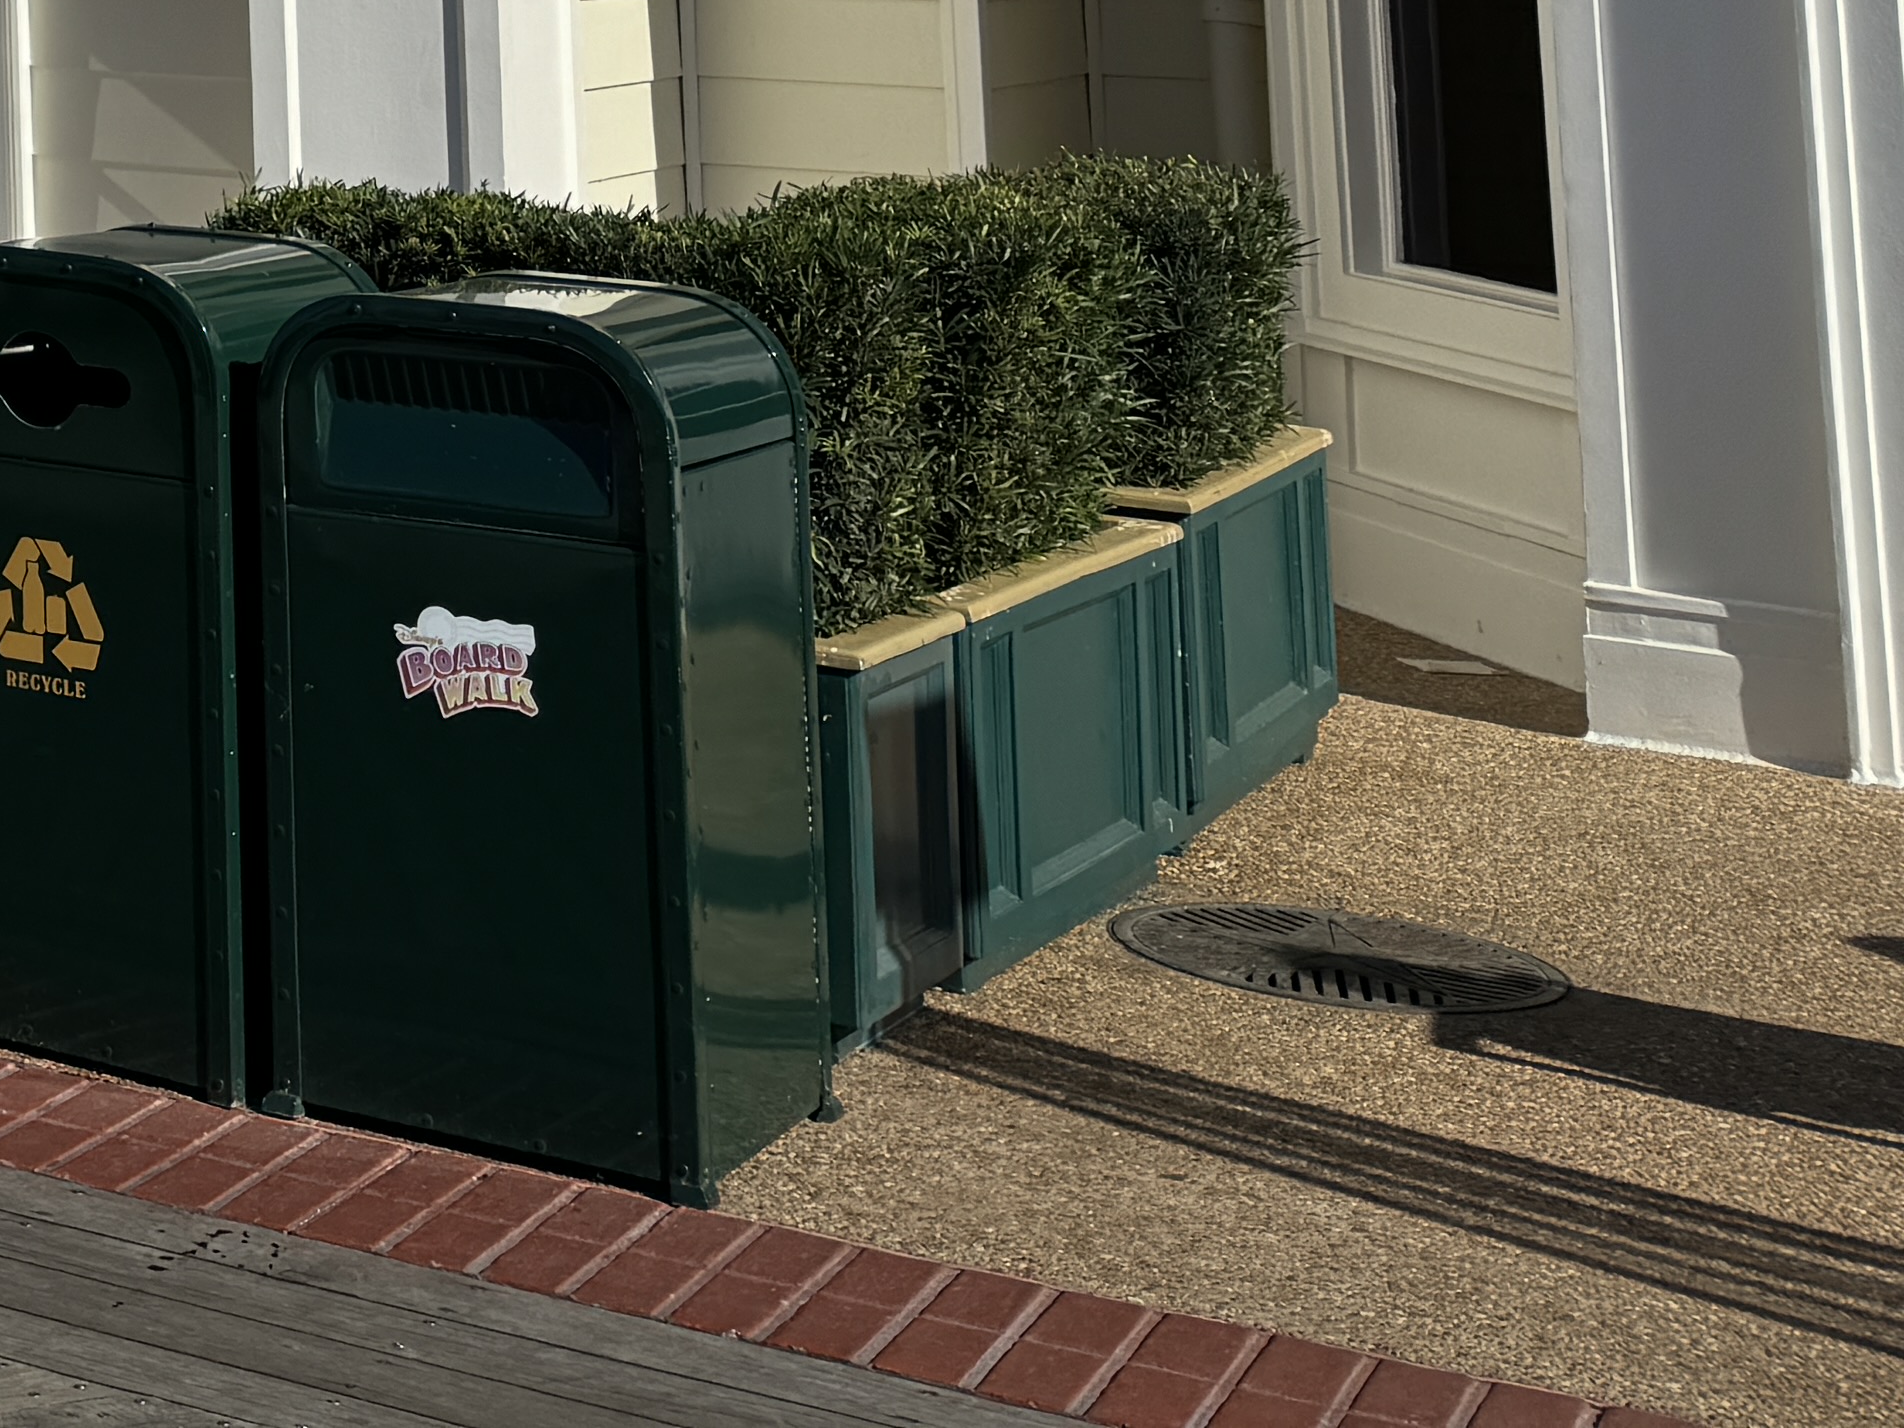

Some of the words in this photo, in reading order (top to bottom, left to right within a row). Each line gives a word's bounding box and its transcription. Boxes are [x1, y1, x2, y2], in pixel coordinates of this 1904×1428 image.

[6, 669, 86, 699] RECYCLE
[398, 642, 528, 698] BOARD
[435, 673, 538, 718] WALK
